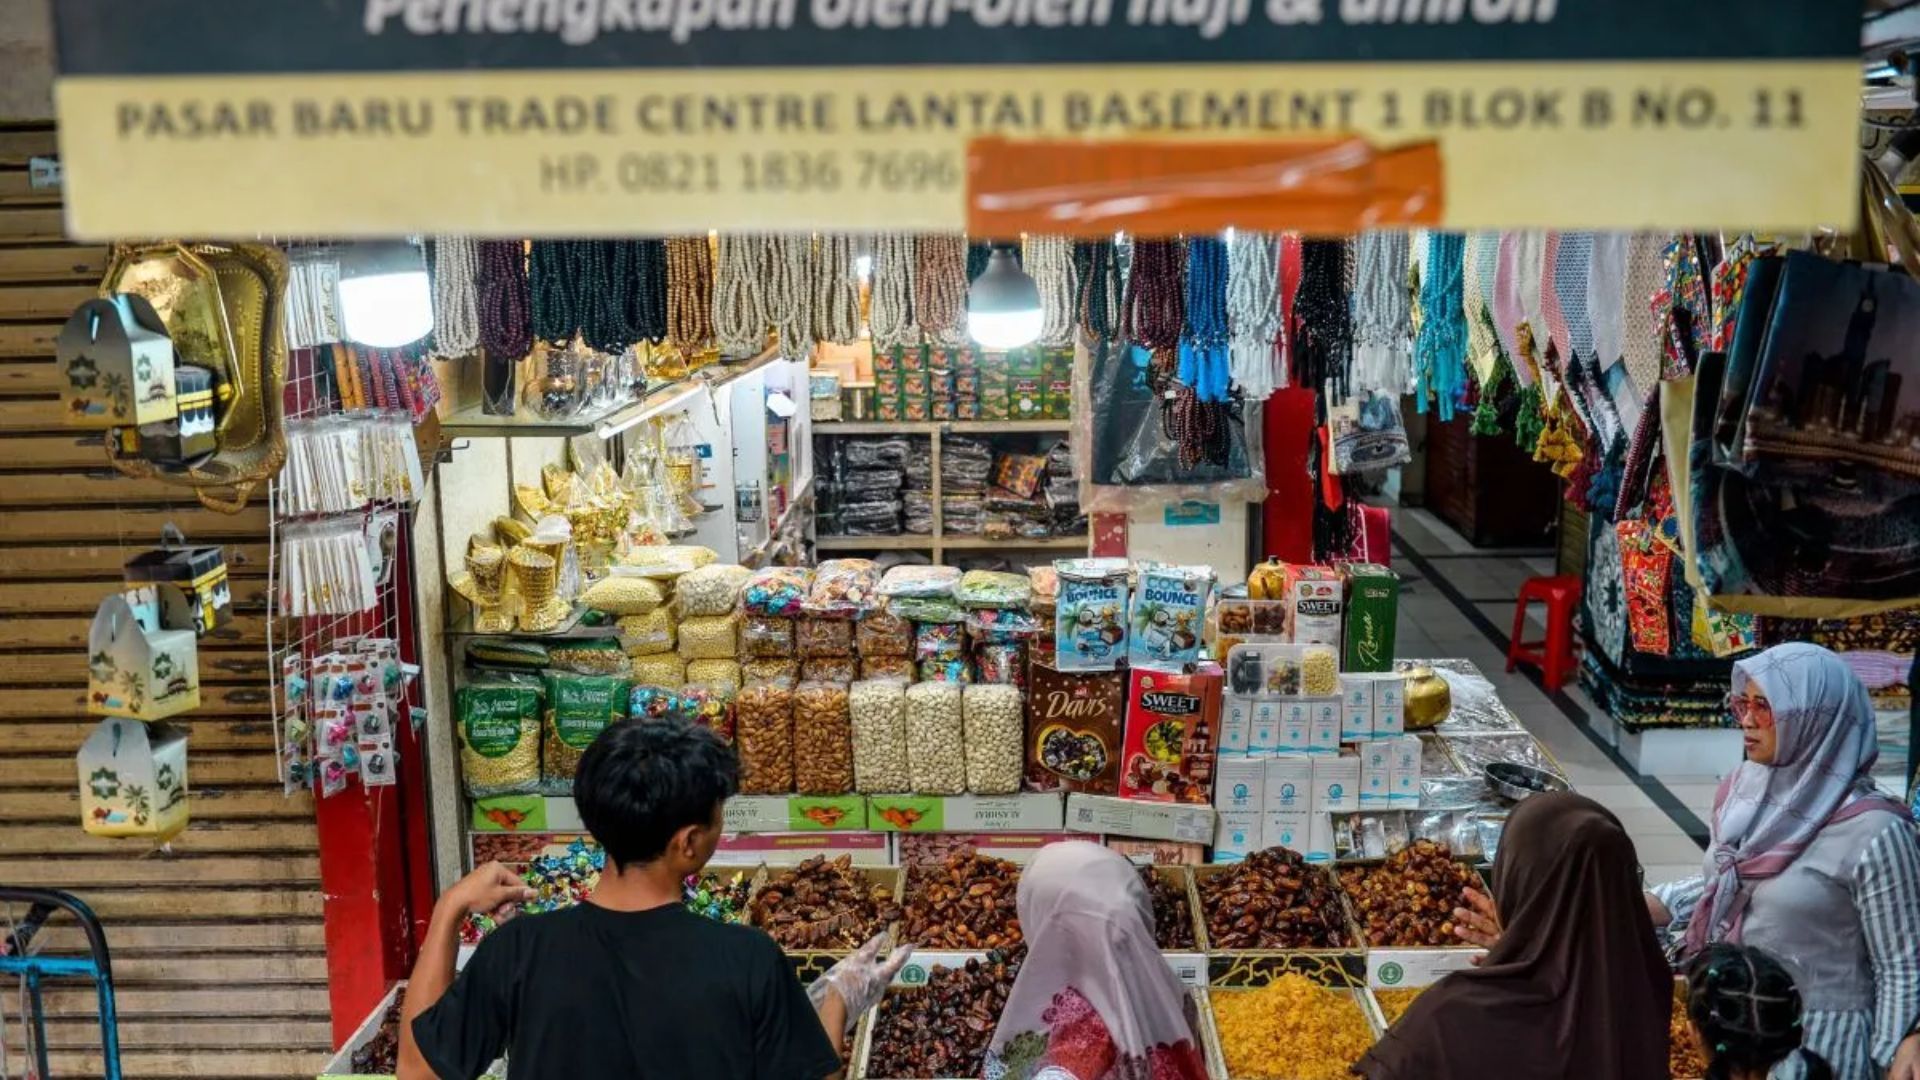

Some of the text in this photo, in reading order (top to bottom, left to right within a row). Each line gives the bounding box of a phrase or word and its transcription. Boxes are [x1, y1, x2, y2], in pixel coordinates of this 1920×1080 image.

[1264, 0, 1323, 25] &
[117, 88, 1805, 138] PASAR BARU TRADE CENTRE LANTAI BASEMENT 1 BLOK B NO. 11
[540, 149, 960, 193] HP. 0821 1836 7696
[1145, 589, 1198, 605] BOUNCE
[1298, 601, 1338, 612] SWEET
[1046, 691, 1107, 719] Davis
[1142, 692, 1200, 710] SWEET
